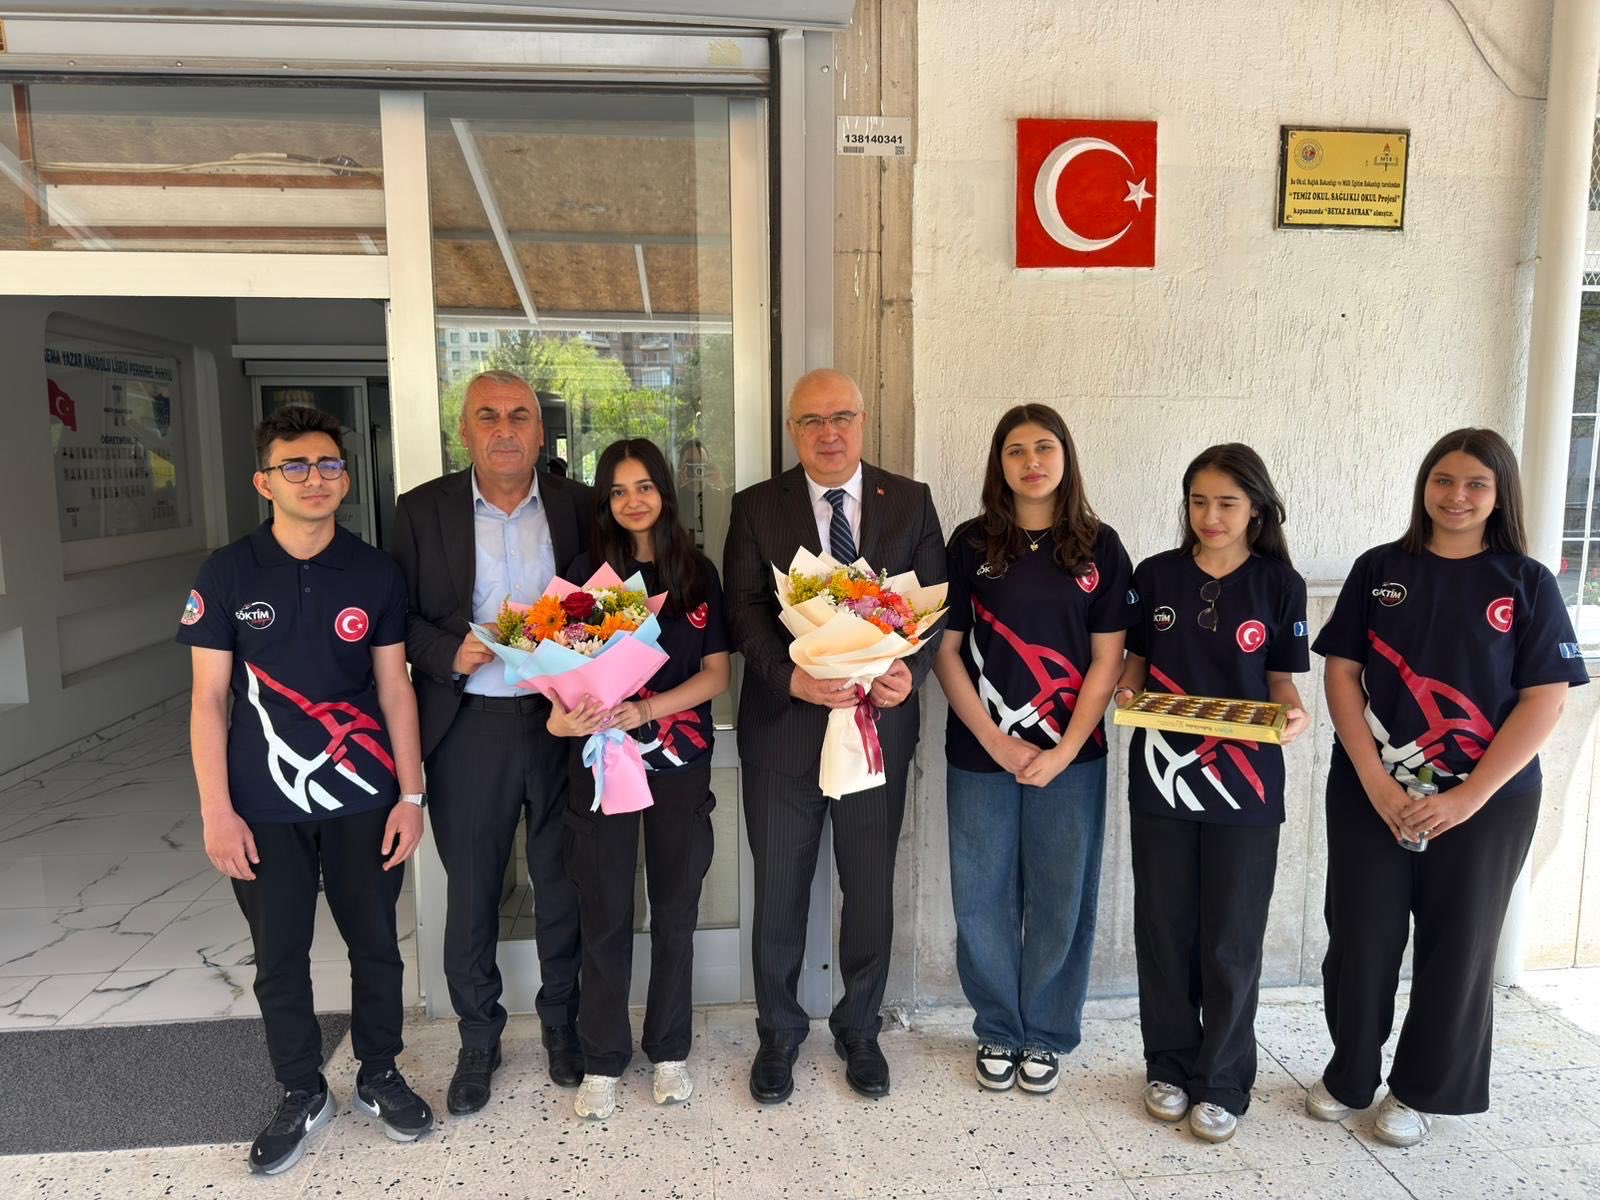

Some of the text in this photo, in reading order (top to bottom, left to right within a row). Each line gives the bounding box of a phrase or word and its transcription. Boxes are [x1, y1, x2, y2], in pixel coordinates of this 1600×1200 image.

[845, 134, 903, 144] 138140341
[1361, 193, 1377, 202] OKUL
[62, 351, 82, 369] YAZAR
[84, 353, 111, 372] ANADOLU
[235, 607, 269, 620] GÖKTİM
